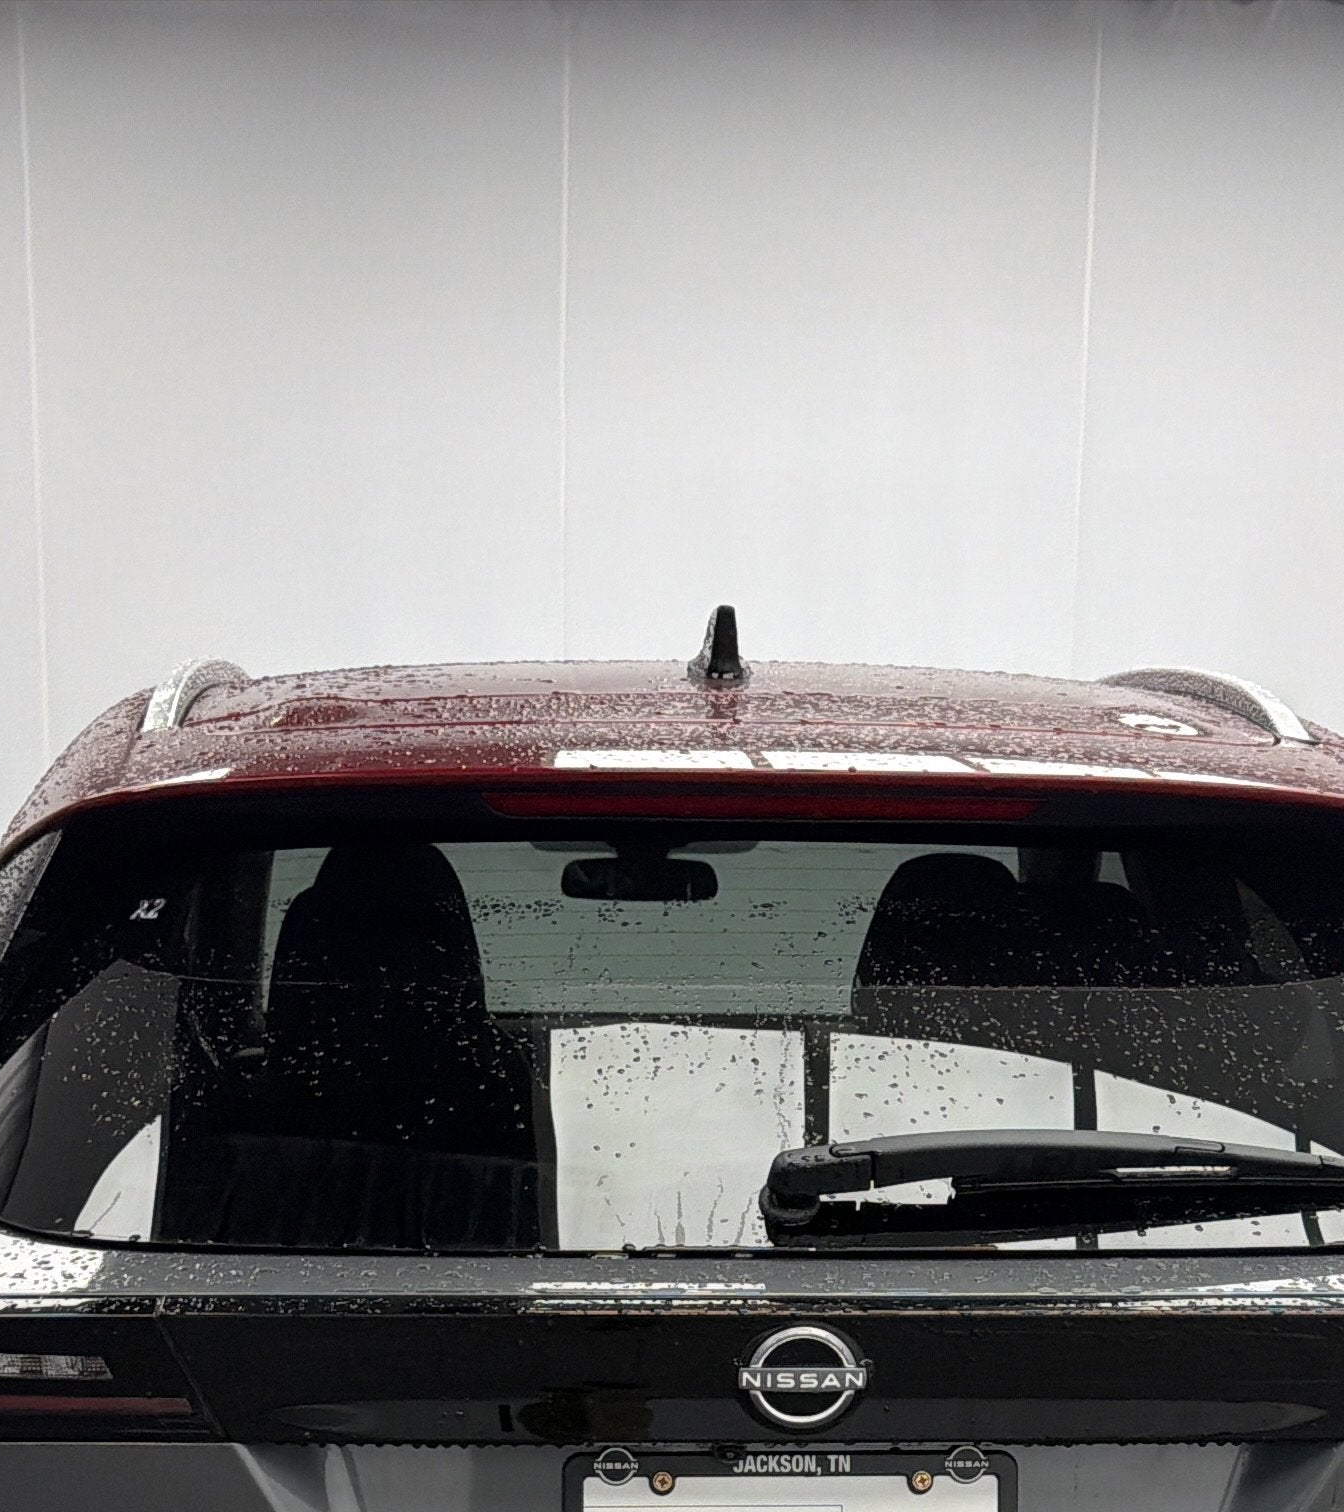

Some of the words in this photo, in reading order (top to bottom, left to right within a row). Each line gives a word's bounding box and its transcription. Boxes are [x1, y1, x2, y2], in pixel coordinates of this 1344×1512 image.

[741, 1368, 865, 1389] NISSAN
[593, 1461, 639, 1471] NISSAN
[733, 1454, 822, 1476] JACKSON,
[827, 1454, 851, 1473] TN
[944, 1459, 990, 1470] NISSAN
